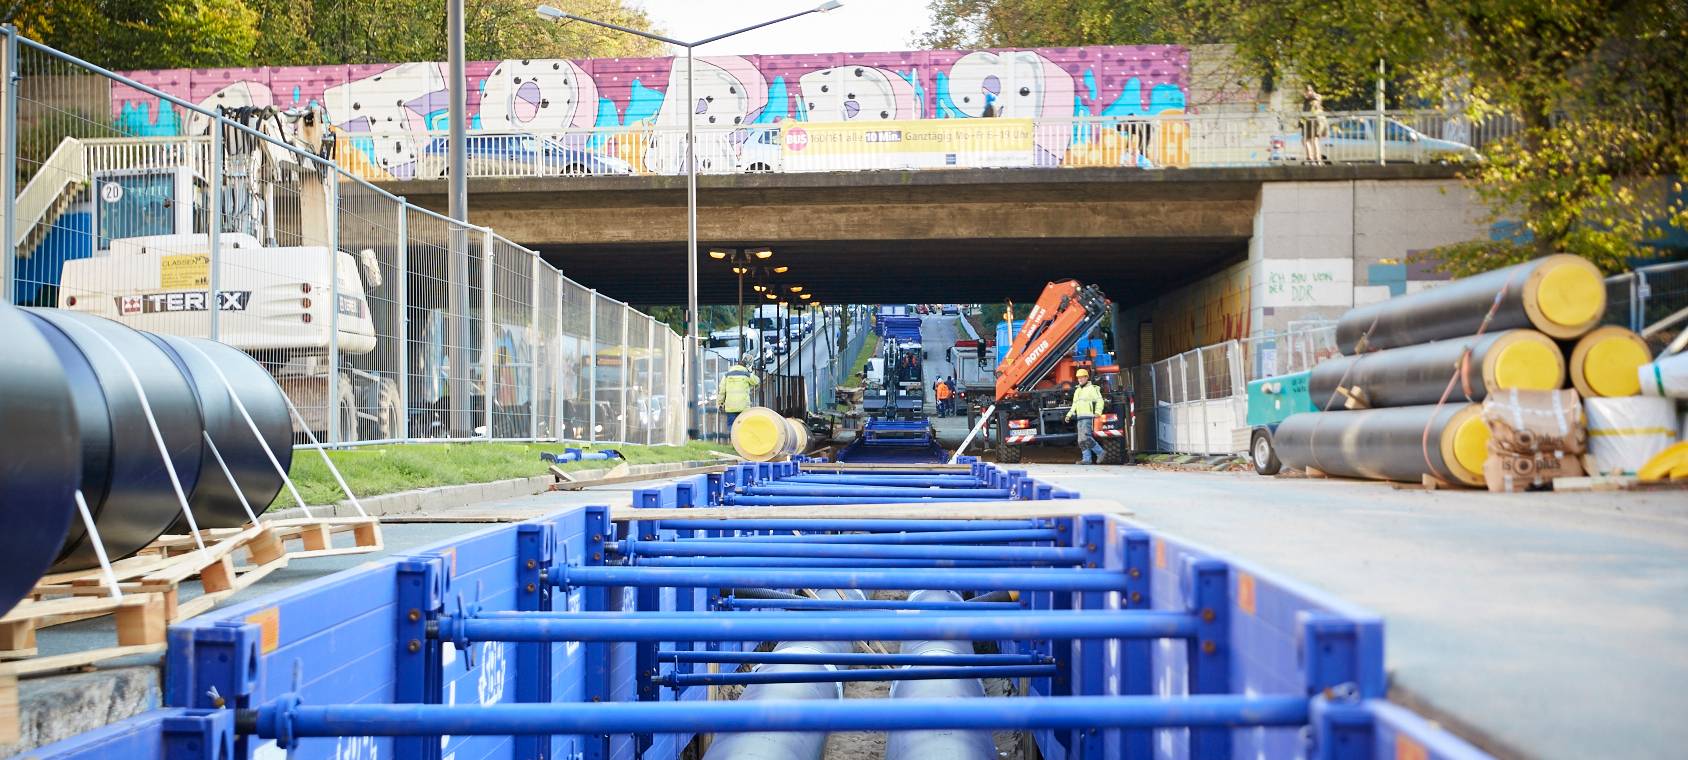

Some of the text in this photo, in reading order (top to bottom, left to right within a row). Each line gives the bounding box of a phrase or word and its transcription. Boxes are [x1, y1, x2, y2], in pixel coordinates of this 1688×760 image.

[785, 133, 808, 145] BUS
[866, 131, 878, 142] 10
[879, 130, 901, 141] Min.
[106, 186, 119, 199] 20
